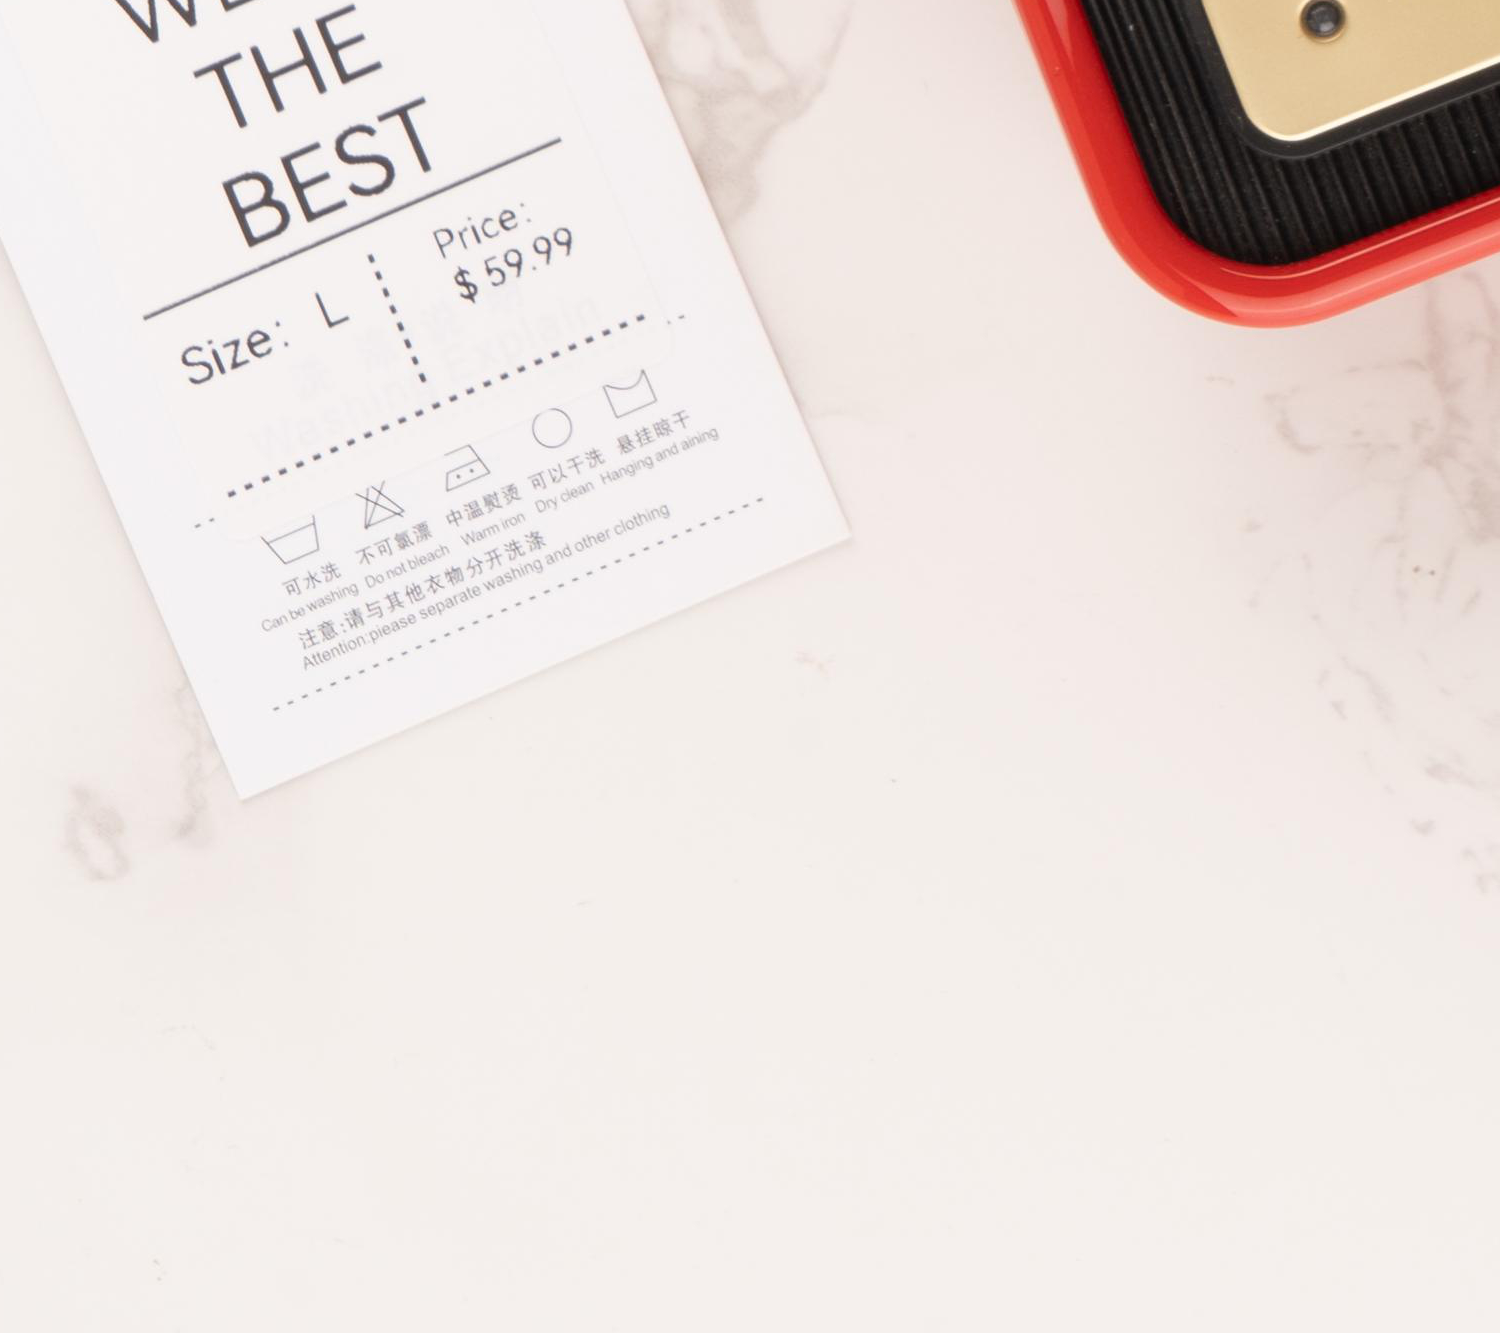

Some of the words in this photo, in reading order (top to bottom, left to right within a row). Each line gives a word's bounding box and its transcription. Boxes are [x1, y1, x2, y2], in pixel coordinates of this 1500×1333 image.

[194, 5, 383, 129] THE
[222, 97, 434, 247] BEST
[433, 202, 534, 258] Price:
[181, 322, 289, 385] Size:
[314, 291, 350, 328] L
[261, 613, 288, 632] Can
[290, 605, 305, 620] be
[307, 582, 359, 612] washing
[364, 571, 384, 589] Do
[386, 561, 406, 579] not
[409, 544, 449, 570] bleach
[461, 529, 500, 547] Warm
[502, 512, 526, 530] iron
[535, 496, 558, 513] Dry
[560, 482, 595, 505] clean
[600, 455, 656, 485] Hanging
[656, 442, 679, 462] and
[282, 562, 342, 597] 可水洗
[527, 448, 606, 490] 可以干洗
[418, 583, 482, 617] separate
[482, 563, 544, 592] washing
[545, 543, 573, 564] and
[575, 528, 611, 553] other
[614, 503, 671, 534] clothing
